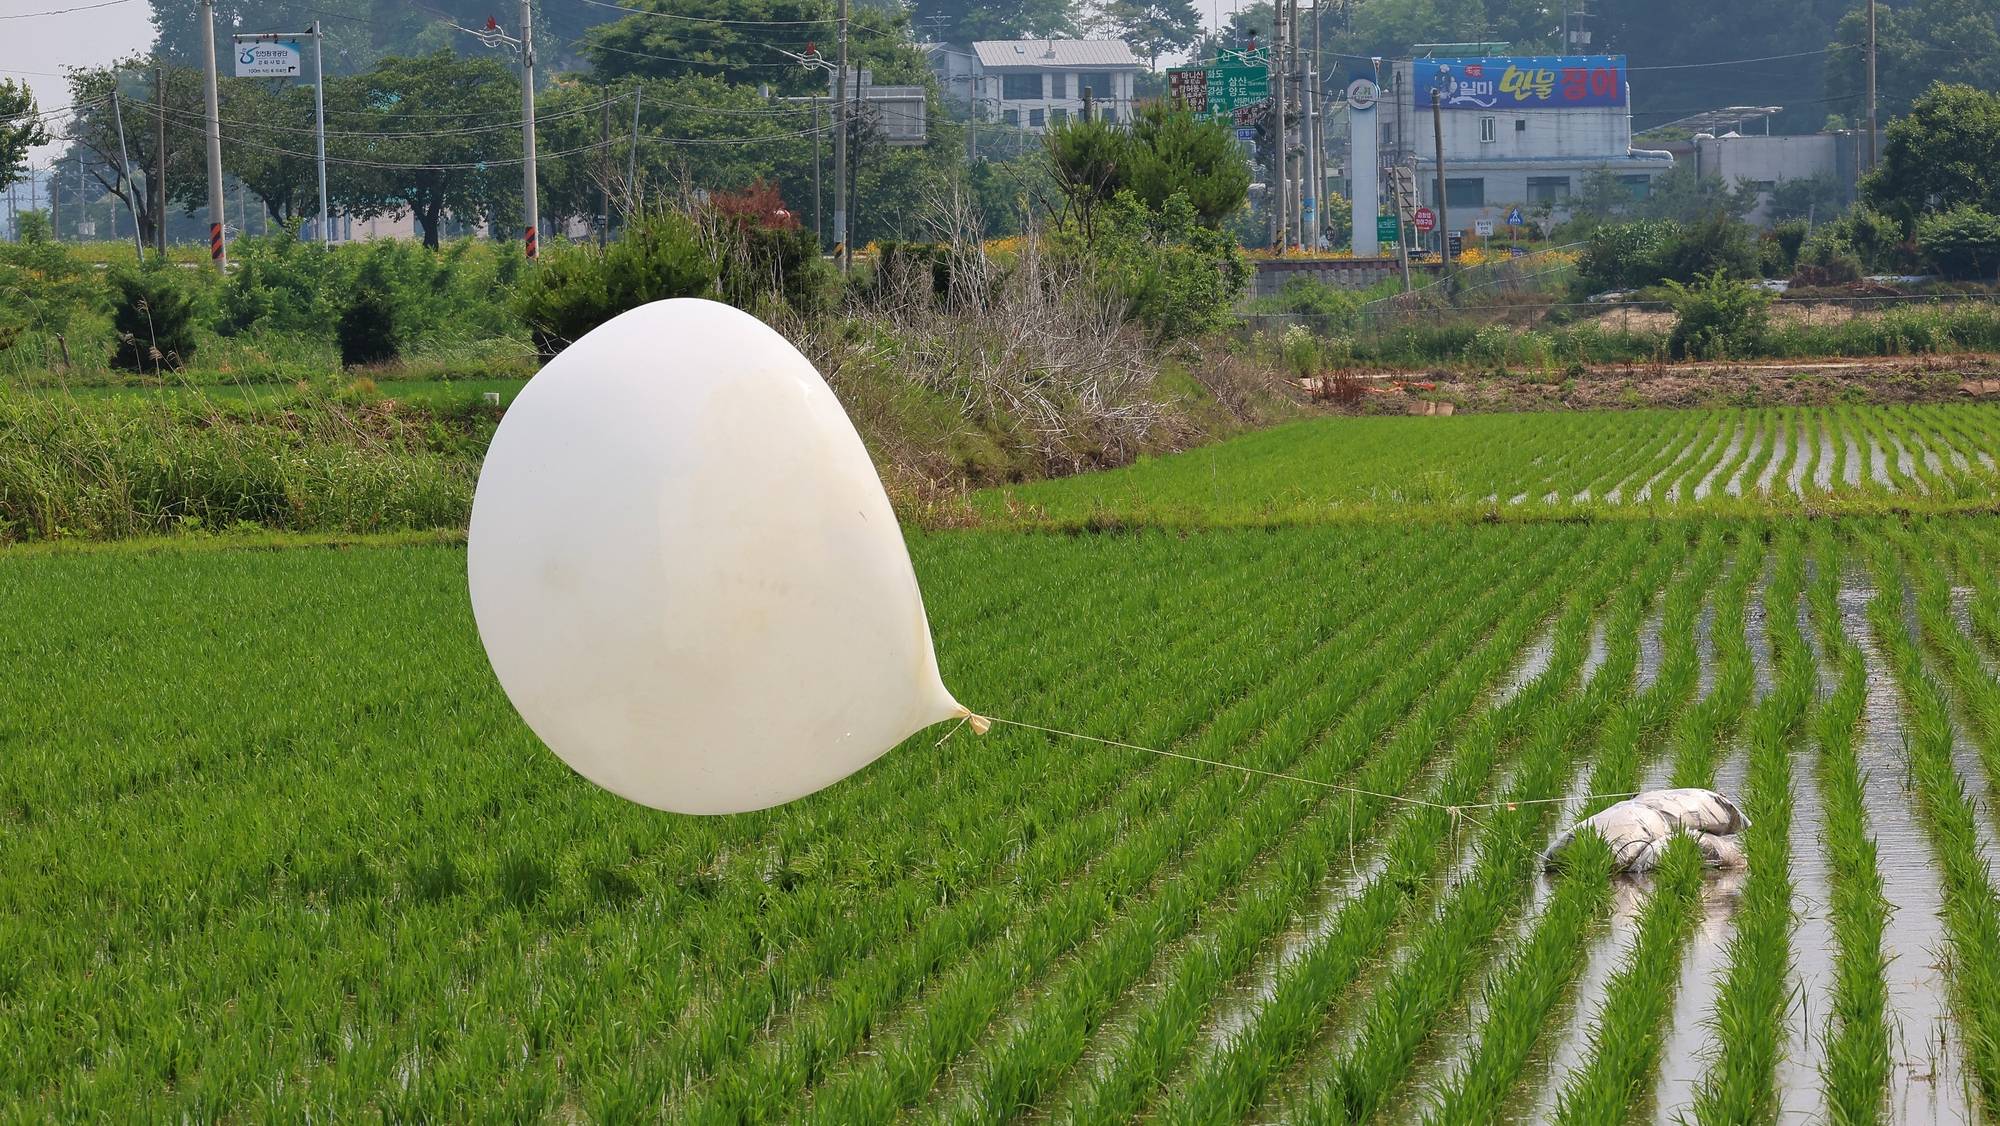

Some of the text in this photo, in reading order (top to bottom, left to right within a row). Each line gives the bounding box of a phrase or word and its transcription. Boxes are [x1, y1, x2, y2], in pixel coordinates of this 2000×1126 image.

[1181, 71, 1204, 79] 마니산
[1228, 76, 1247, 87] 삼산
[1460, 64, 1617, 101] 일미 민물 장어
[1228, 87, 1248, 97] 양도
